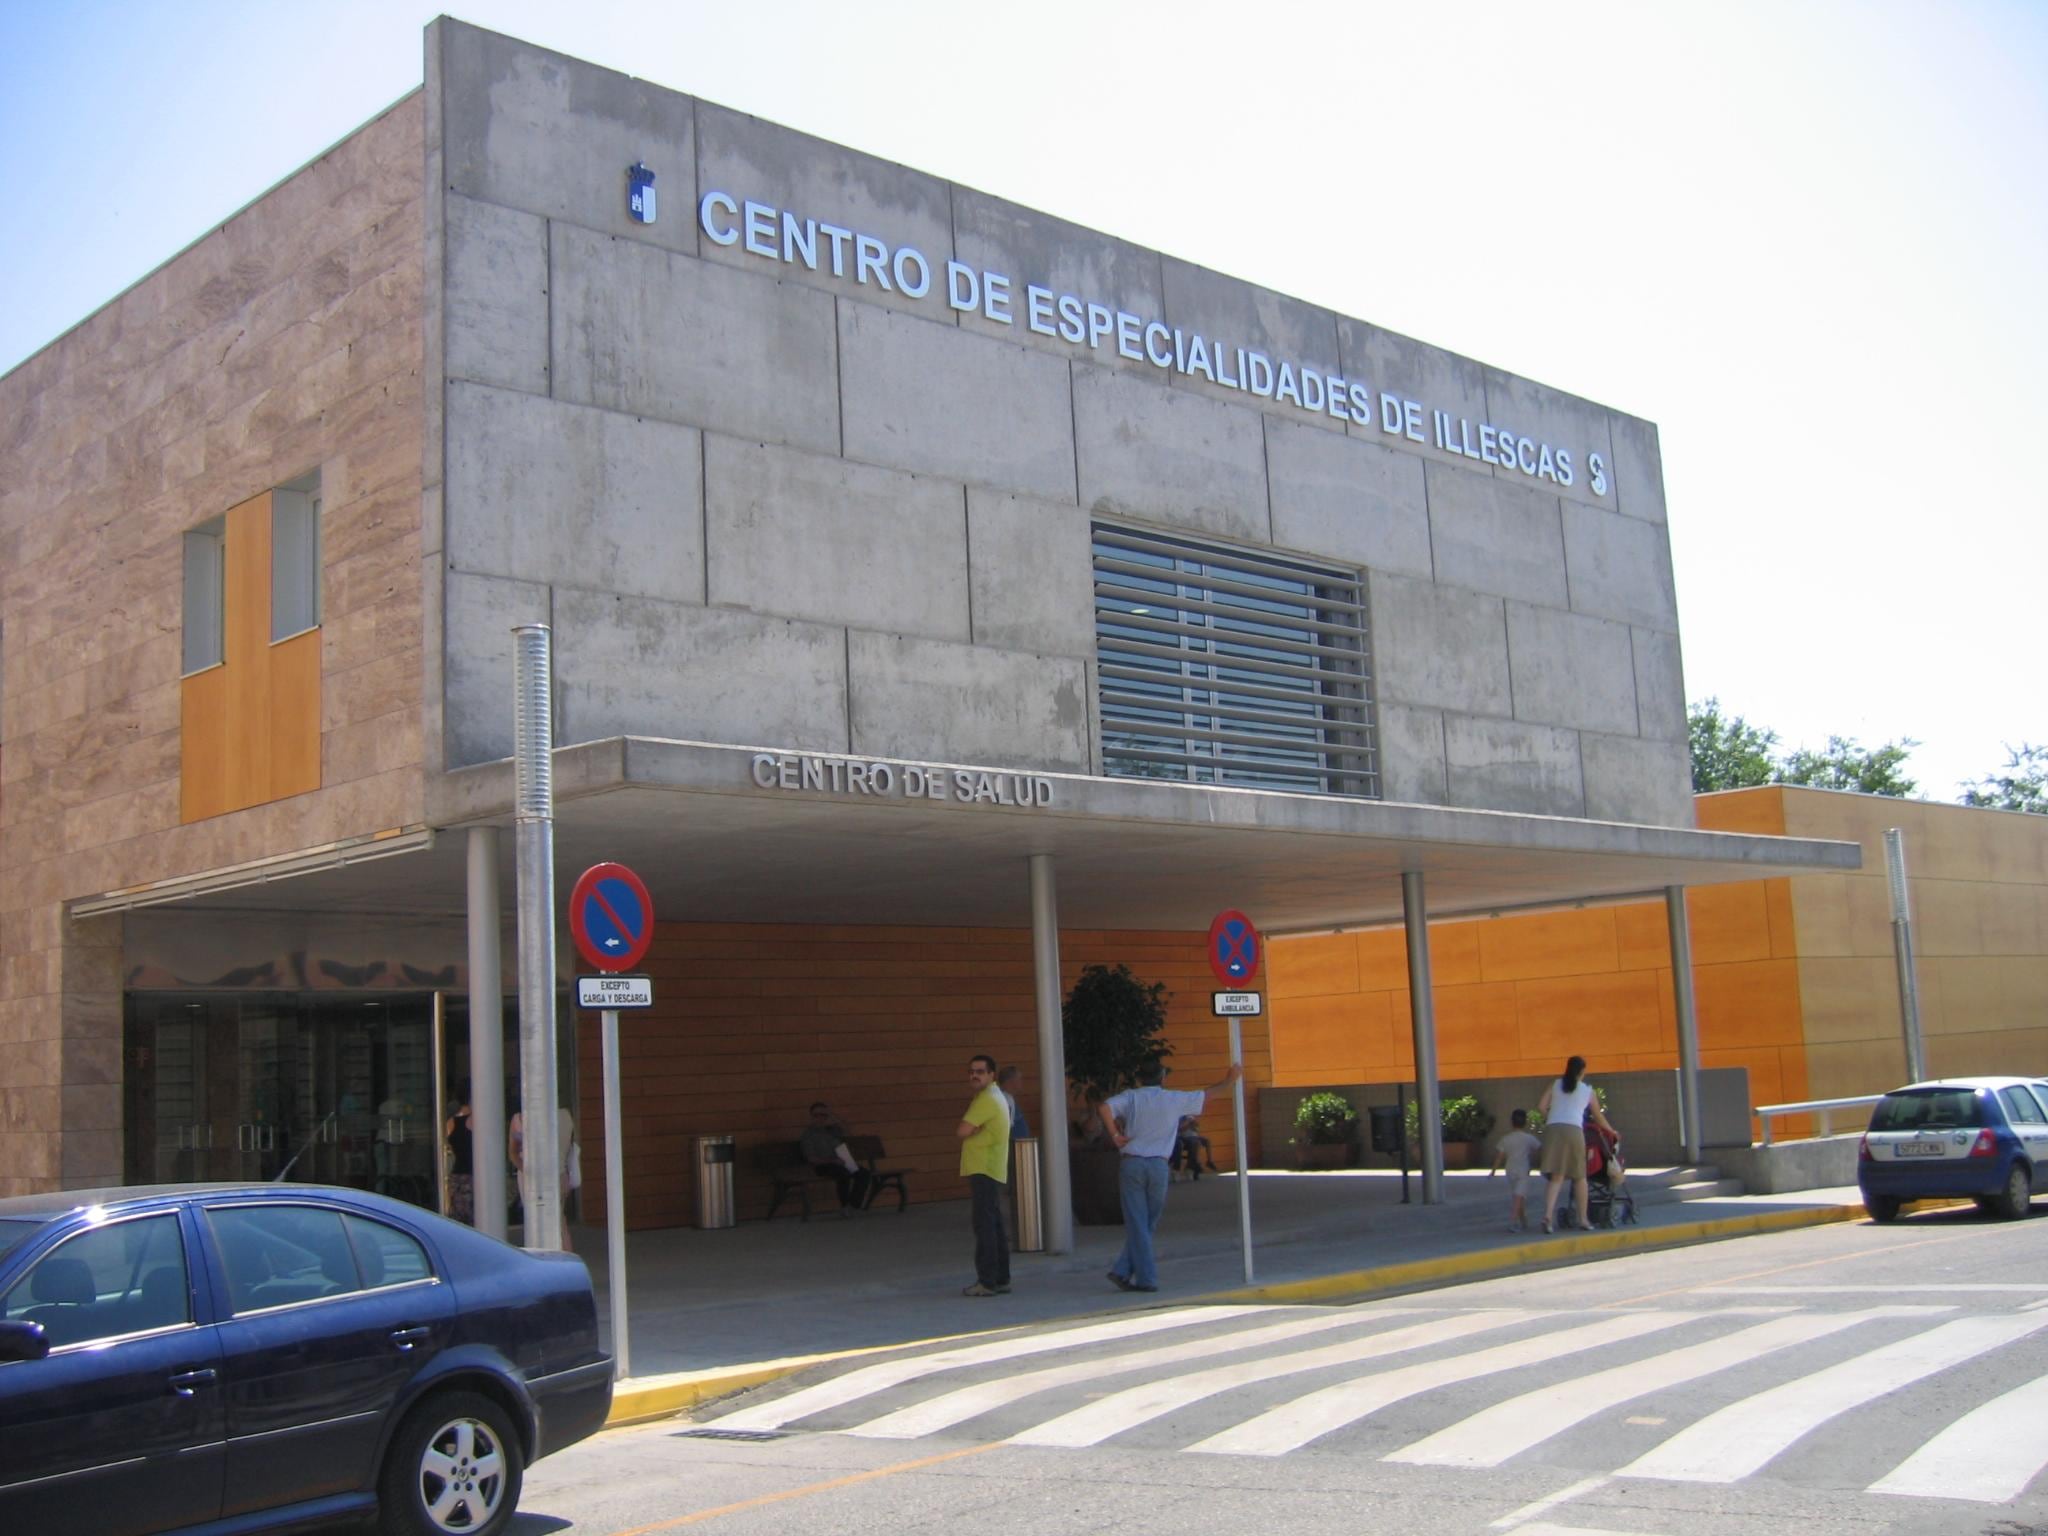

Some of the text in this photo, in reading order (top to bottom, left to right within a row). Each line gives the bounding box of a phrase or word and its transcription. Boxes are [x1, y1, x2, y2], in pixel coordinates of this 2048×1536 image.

[700, 191, 1575, 487] CENTRO DE ESPECIALIDADES DE ILLESCAS
[752, 753, 1055, 808] CENTRO DE SALUD
[583, 993, 649, 1003] CARGA Y DESCARGA
[600, 981, 630, 990] EXCEPTO
